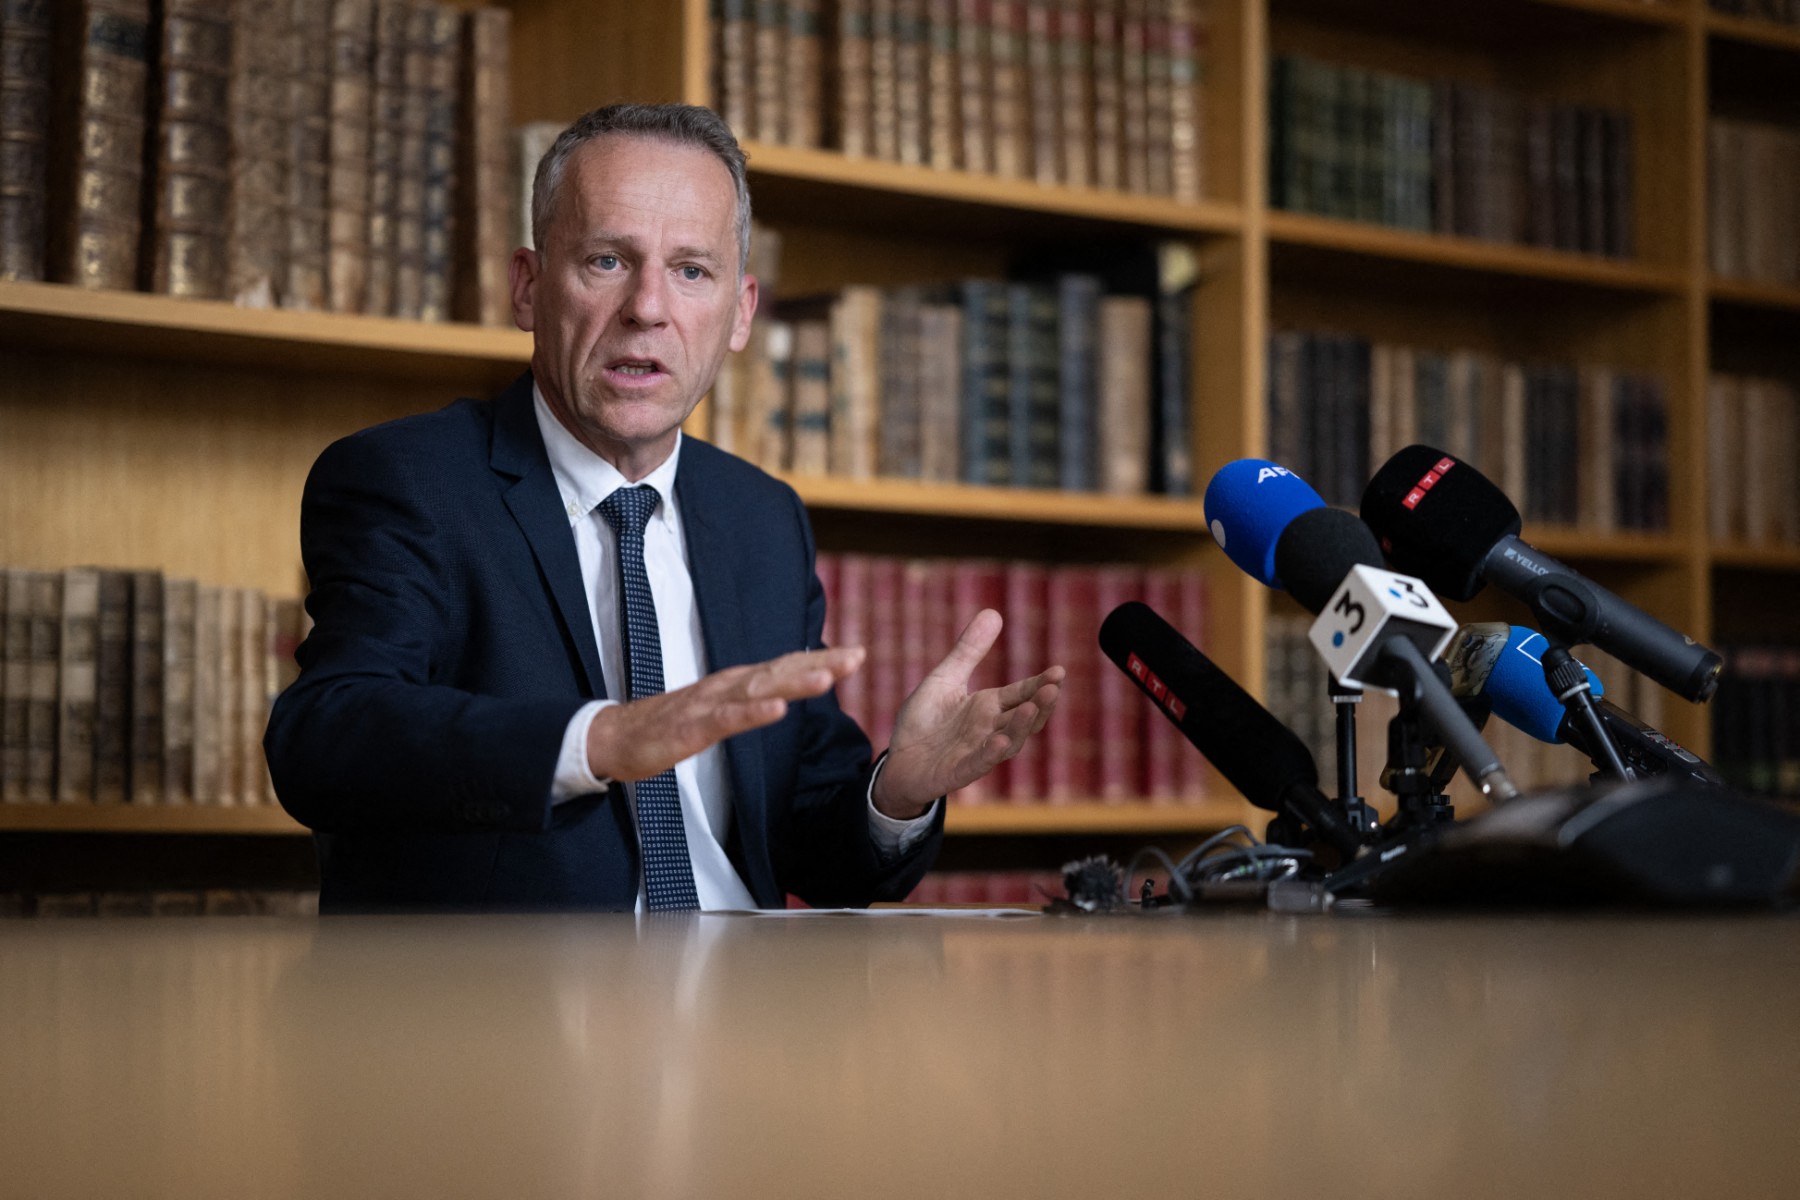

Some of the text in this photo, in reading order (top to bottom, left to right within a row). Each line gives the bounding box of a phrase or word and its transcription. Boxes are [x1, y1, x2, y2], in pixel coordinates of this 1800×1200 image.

[1258, 466, 1300, 484] AF
[1407, 462, 1451, 505] RTL
[1334, 588, 1366, 635] 3
[1393, 578, 1429, 609] 3
[1131, 660, 1179, 716] RTL
